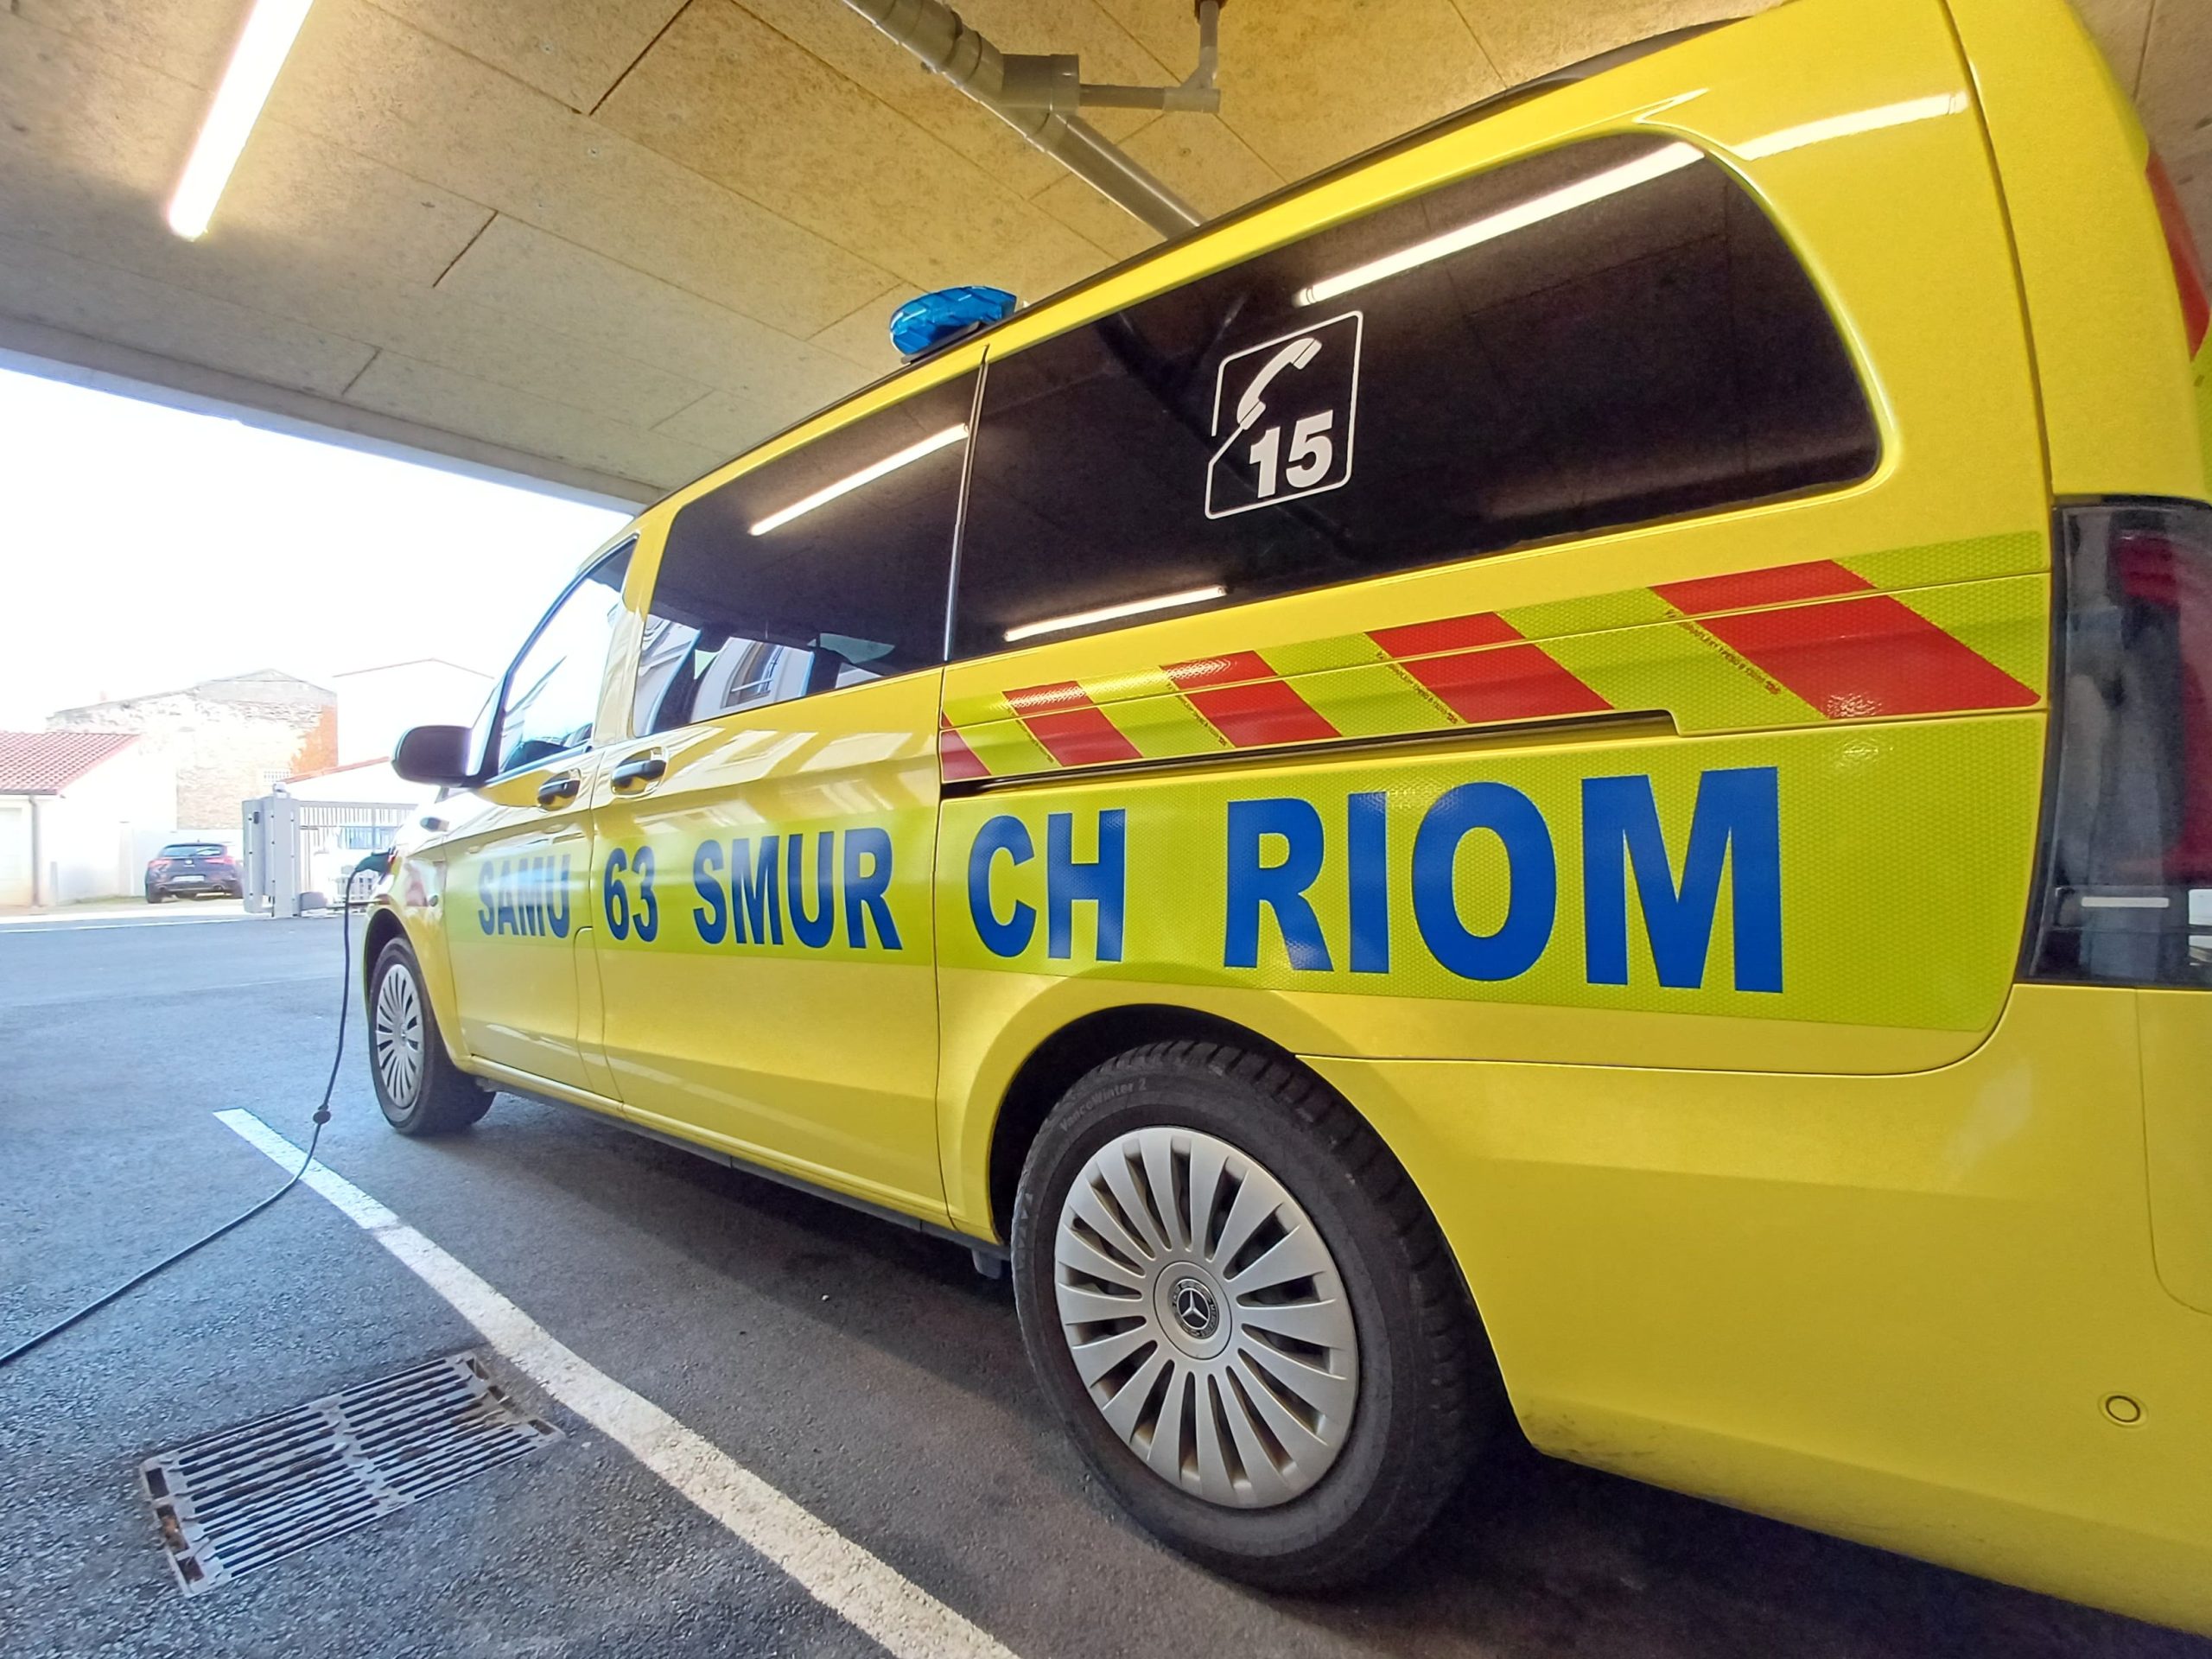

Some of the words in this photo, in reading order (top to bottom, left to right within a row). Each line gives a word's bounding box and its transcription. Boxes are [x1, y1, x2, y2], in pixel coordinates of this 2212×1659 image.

[1249, 409, 1333, 499] 15
[478, 854, 570, 938] SAMU
[603, 846, 658, 943] 63
[692, 827, 903, 950] SMUR
[969, 809, 1127, 962] CH
[1224, 766, 1783, 993] RIOM
[1059, 1082, 1134, 1132] VancoWinter
[1138, 1077, 1147, 1091] 2
